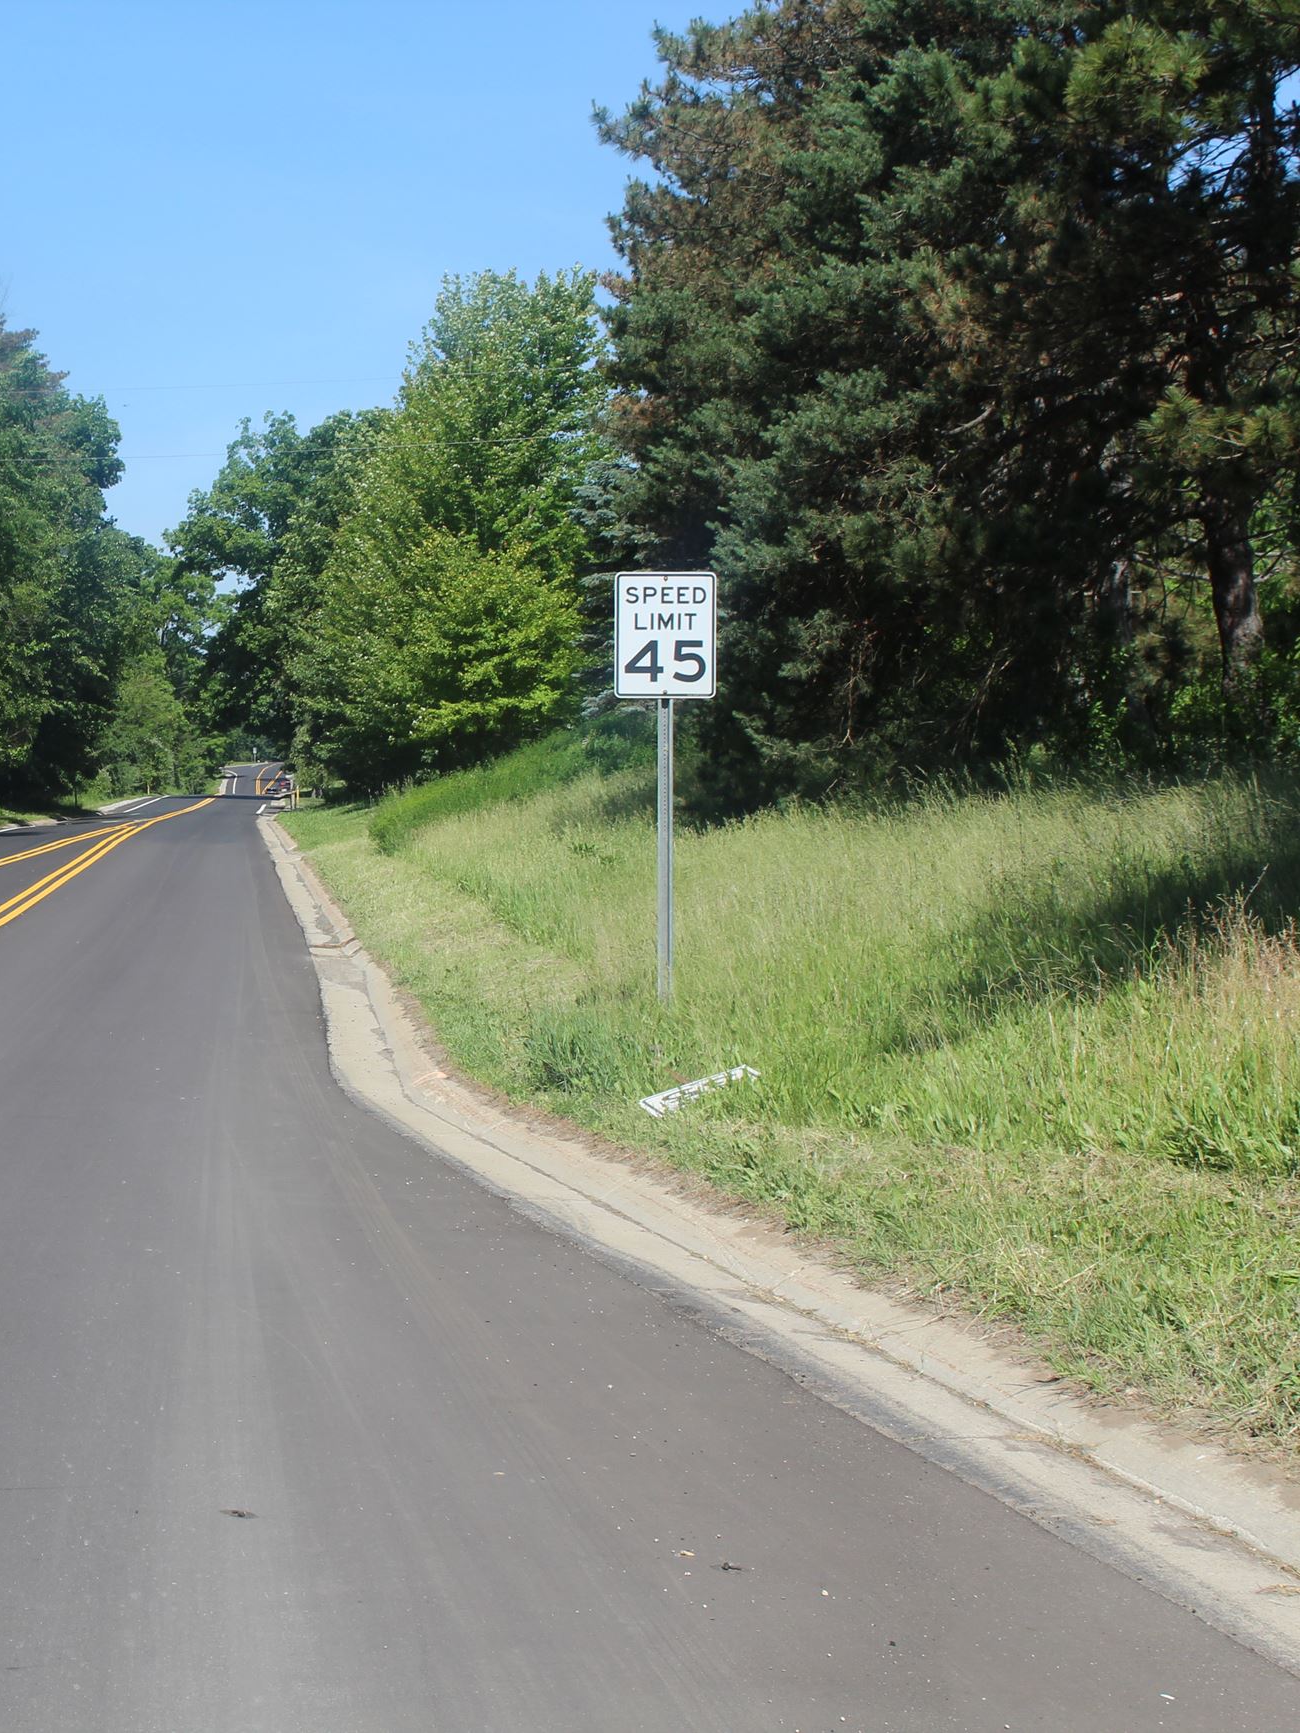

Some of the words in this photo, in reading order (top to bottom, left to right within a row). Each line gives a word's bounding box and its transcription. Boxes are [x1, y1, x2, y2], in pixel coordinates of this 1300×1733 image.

[626, 586, 707, 604] SPEED
[634, 613, 697, 630] LIMIT
[624, 640, 707, 683] 45
